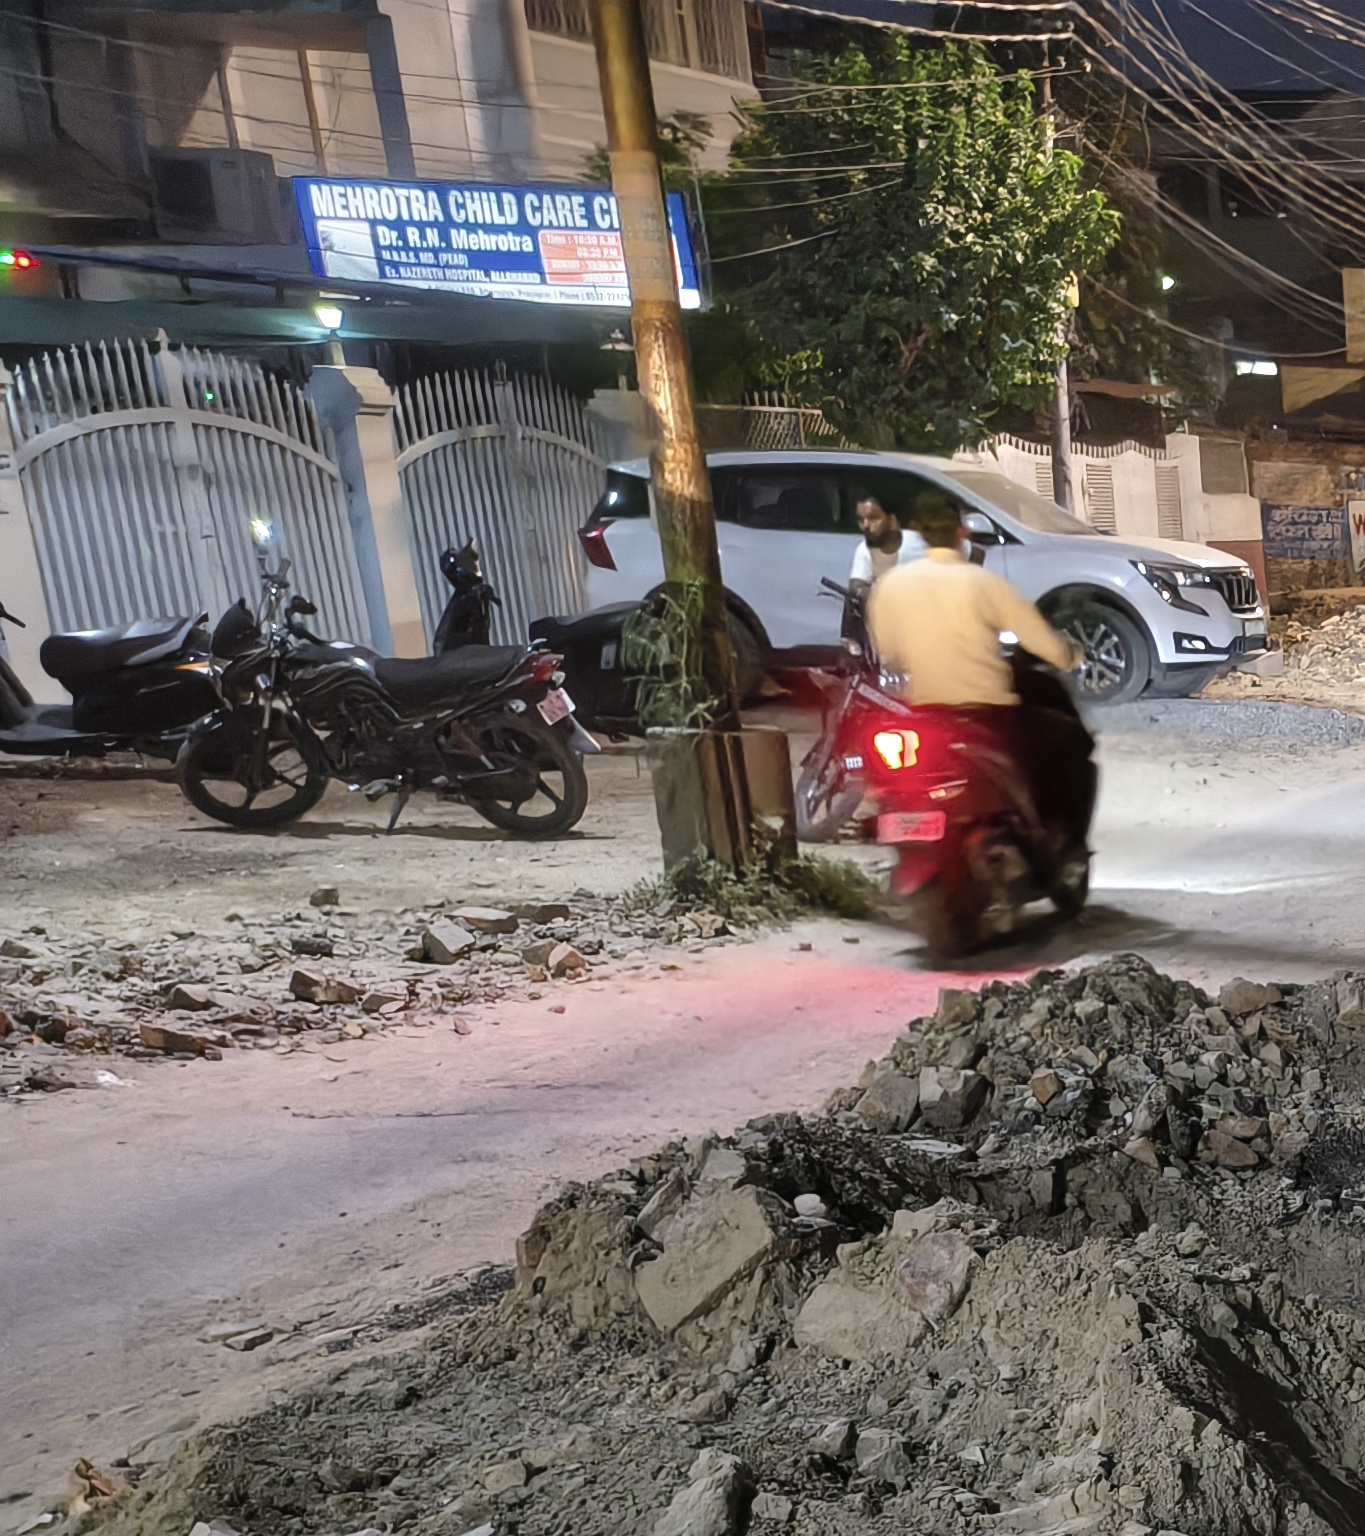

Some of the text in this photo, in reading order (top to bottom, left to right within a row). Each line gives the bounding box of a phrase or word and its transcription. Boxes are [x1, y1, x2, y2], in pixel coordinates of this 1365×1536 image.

[309, 184, 445, 222] MEHROTRA
[449, 189, 518, 225] CHILD
[525, 193, 588, 228] CARE
[376, 225, 533, 252] Dr. R.N. Mehrotra
[445, 268, 490, 283] HOSPITAL,
